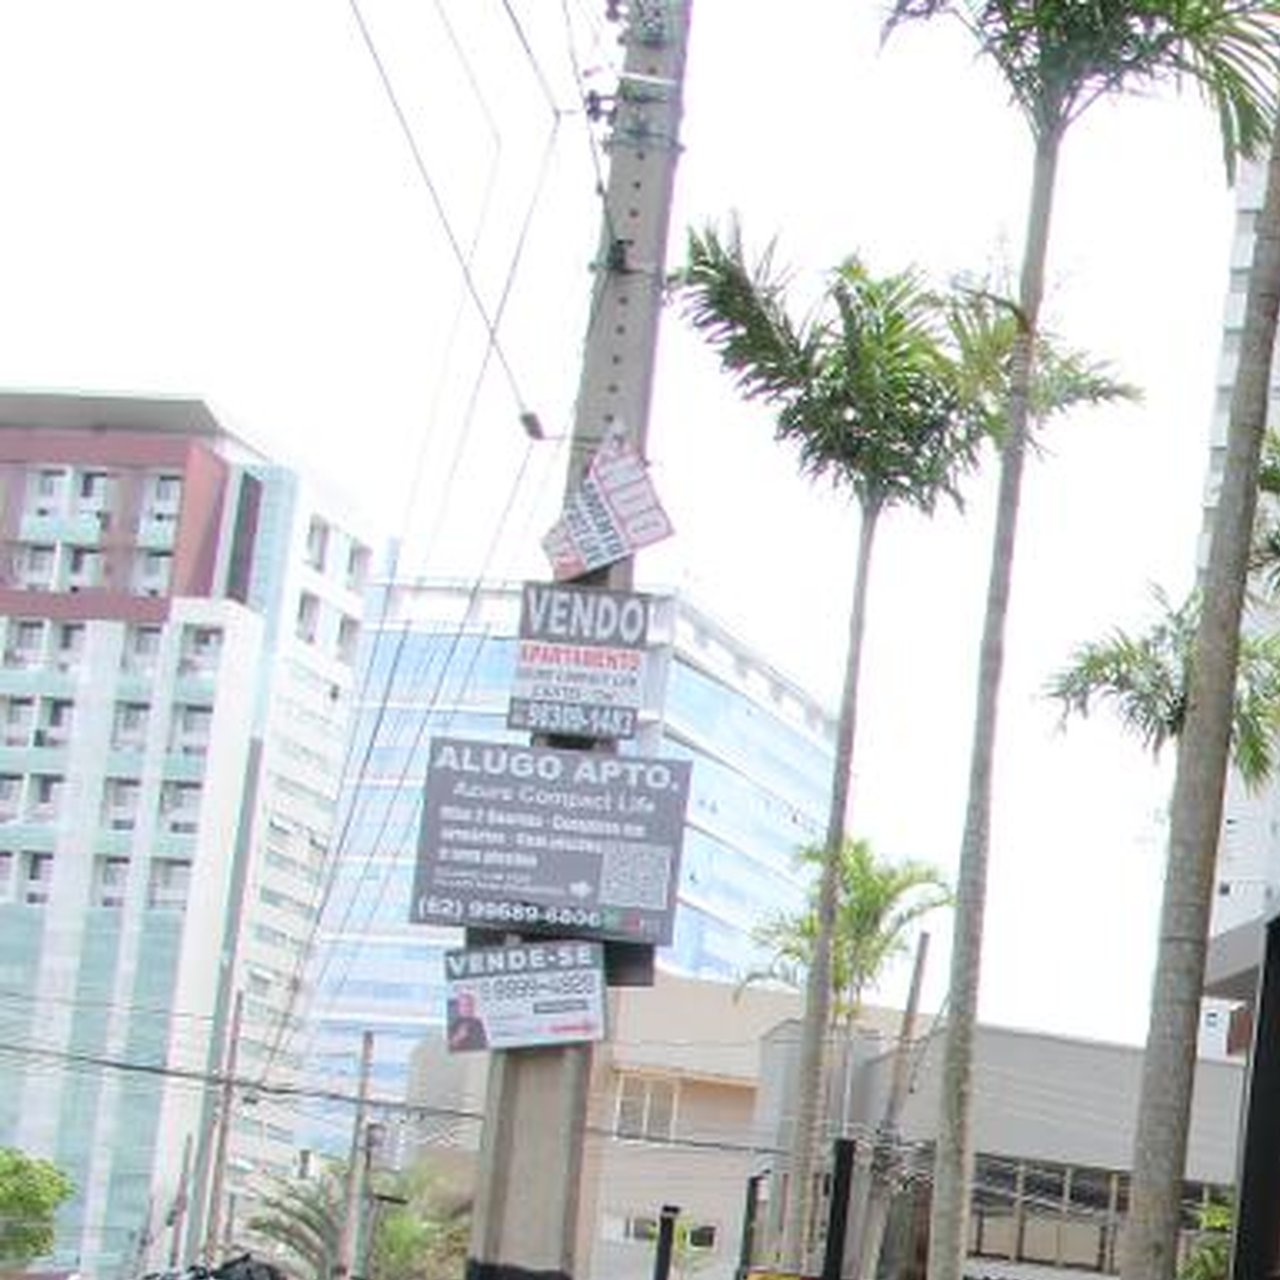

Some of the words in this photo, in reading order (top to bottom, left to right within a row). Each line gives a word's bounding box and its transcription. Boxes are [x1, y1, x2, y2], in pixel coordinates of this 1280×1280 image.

[527, 587, 645, 644] VENDO
[434, 746, 563, 779] ALUGO
[573, 761, 680, 791] APTO.
[447, 943, 594, 978] VENDE-SE
